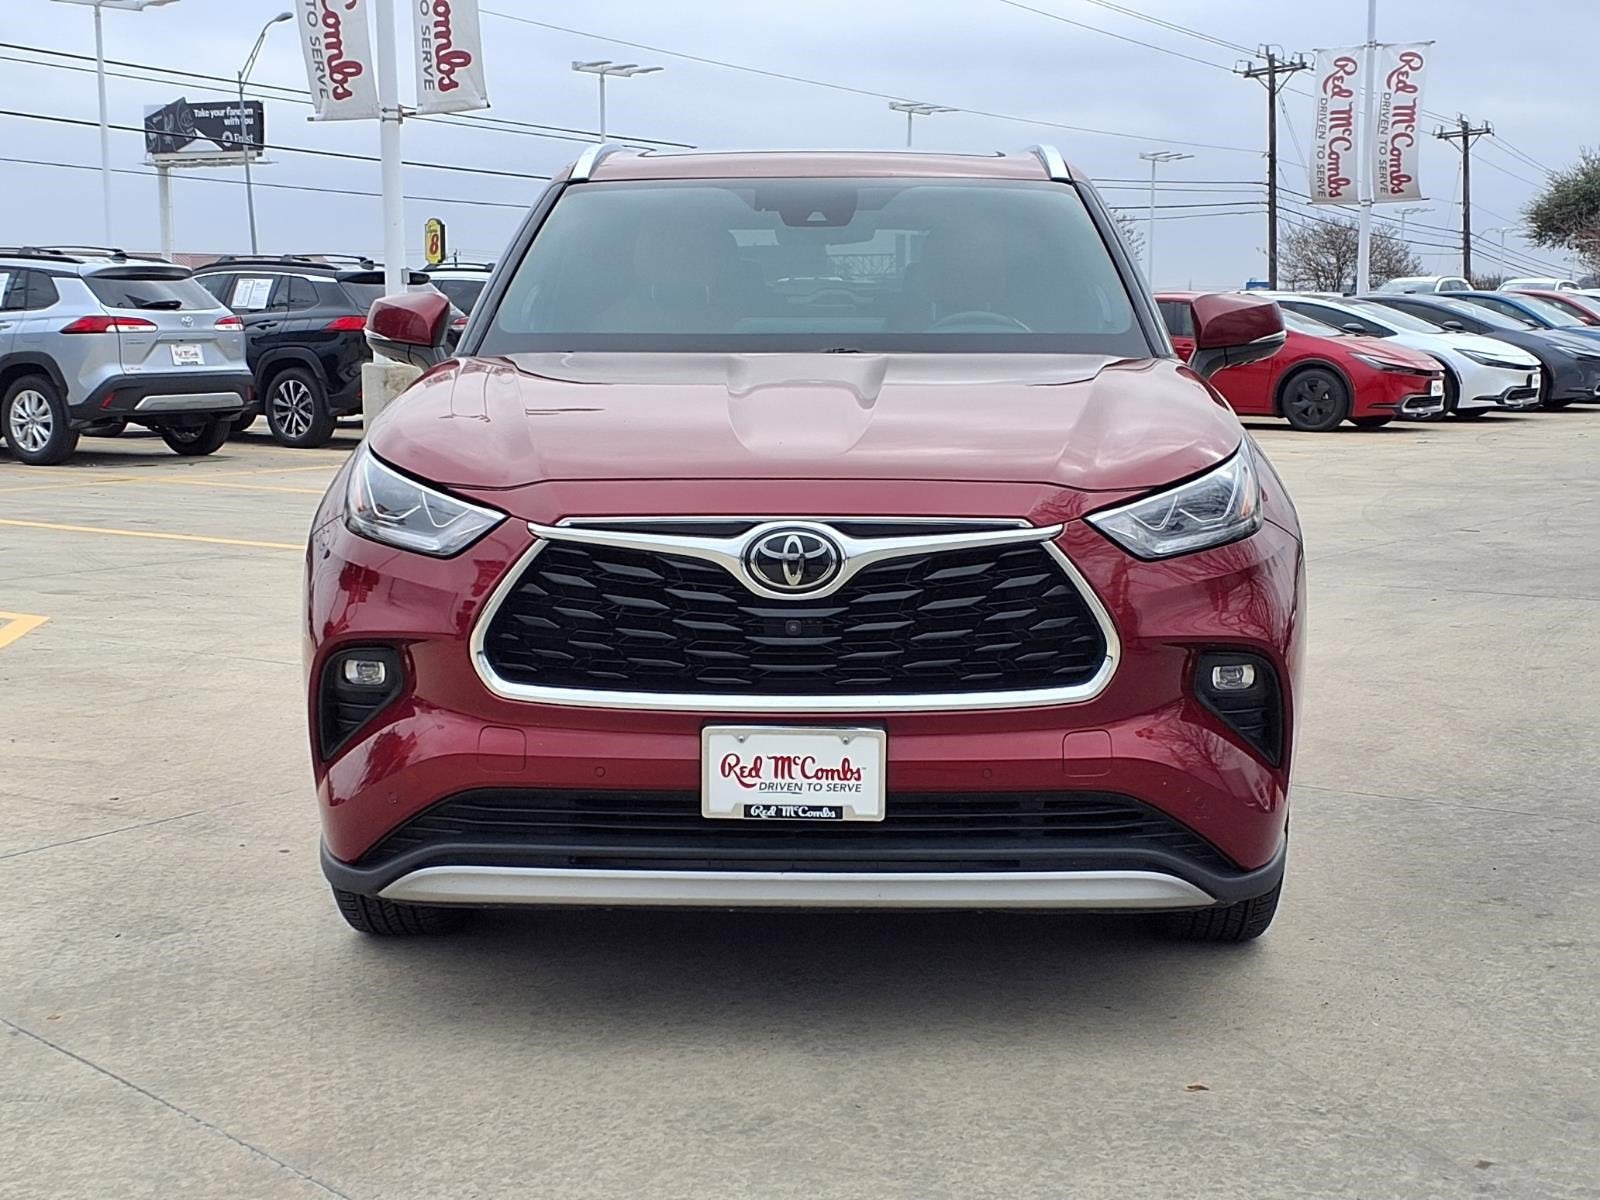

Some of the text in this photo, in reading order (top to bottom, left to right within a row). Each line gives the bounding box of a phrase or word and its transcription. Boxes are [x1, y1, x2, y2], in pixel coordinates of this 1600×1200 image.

[309, 36, 330, 100] SERVE
[421, 25, 435, 91] SERVE
[193, 108, 209, 117] Take
[210, 109, 225, 119] your
[223, 116, 240, 126] with
[1322, 56, 1358, 198] Red McCombs
[1386, 52, 1424, 195] Red McCombs
[1316, 97, 1328, 197] DRIVEN TO SERVE
[1379, 92, 1392, 193] DRIVEN TO SERVE
[430, 233, 439, 255] 8
[720, 753, 862, 789] Red McCombs
[758, 782, 862, 793] DRIVEN TO SERVE
[750, 805, 836, 819] Red McCombs
